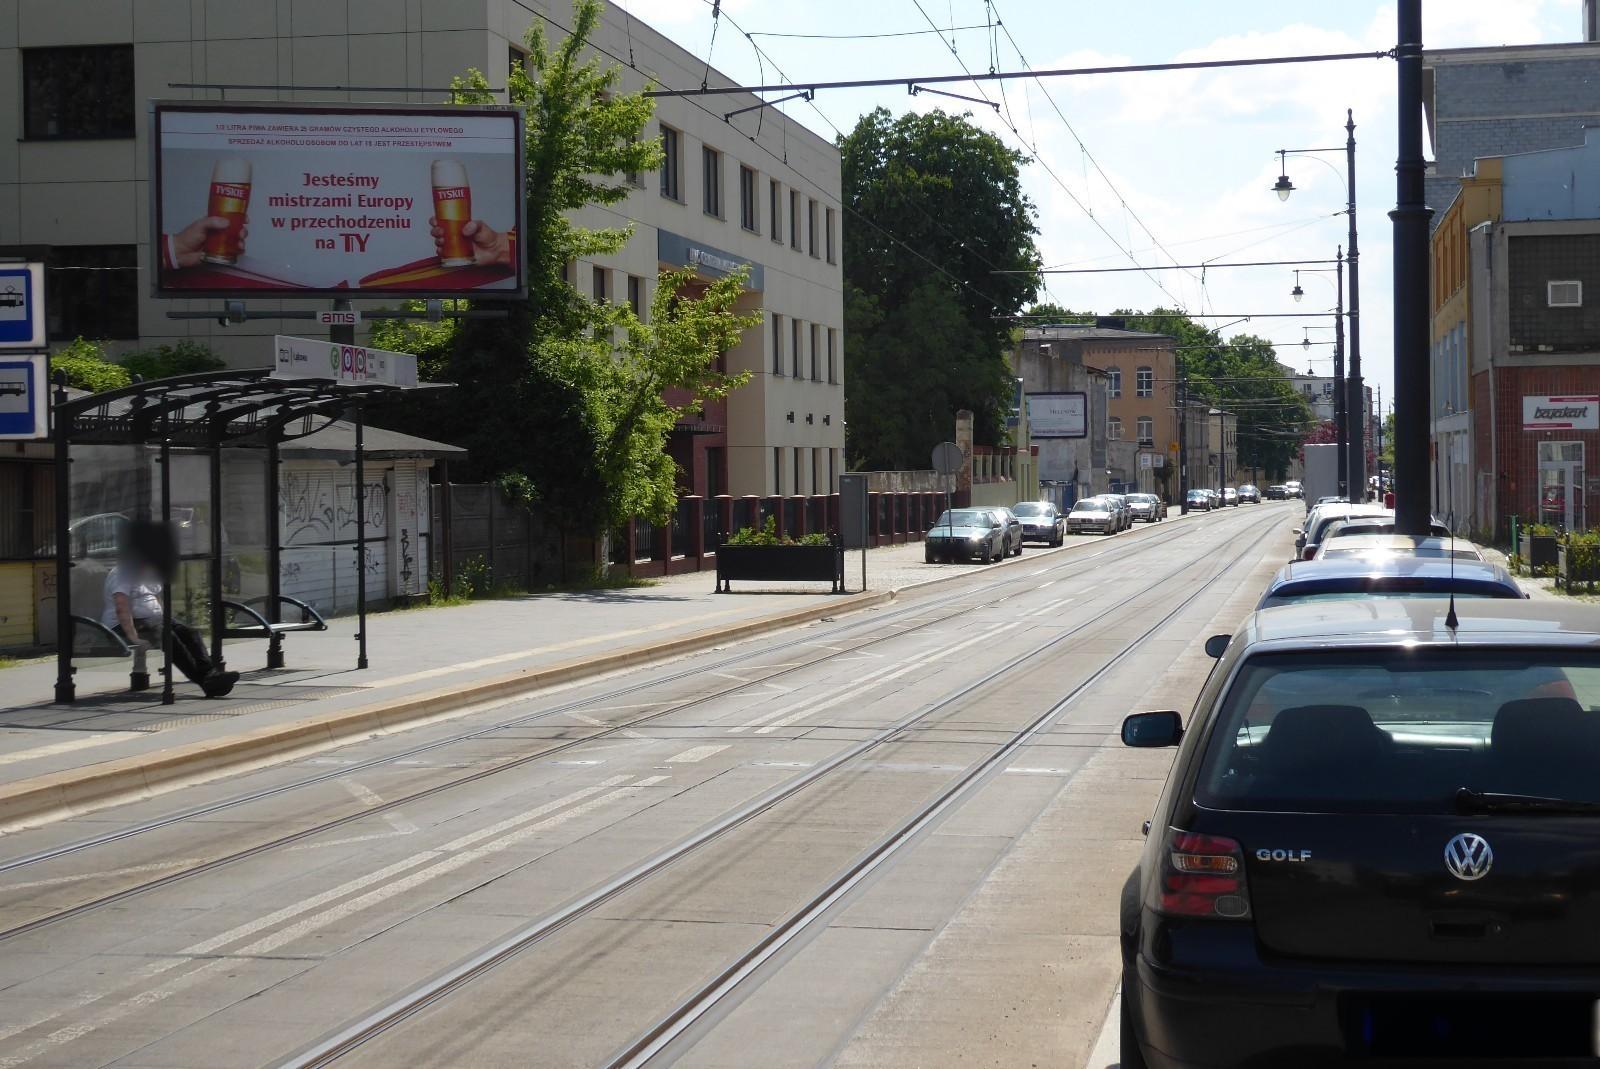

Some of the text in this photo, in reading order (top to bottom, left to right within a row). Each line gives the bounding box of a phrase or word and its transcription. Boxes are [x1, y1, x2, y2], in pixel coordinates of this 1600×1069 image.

[303, 173, 380, 190] Jesteśmy
[216, 185, 245, 198] TYSKIE
[268, 193, 413, 210] mistrzami Europy
[271, 214, 411, 231] w przechodzeniu
[315, 233, 371, 253] na TY
[322, 312, 355, 324] ams
[1256, 848, 1312, 862] GOLF
